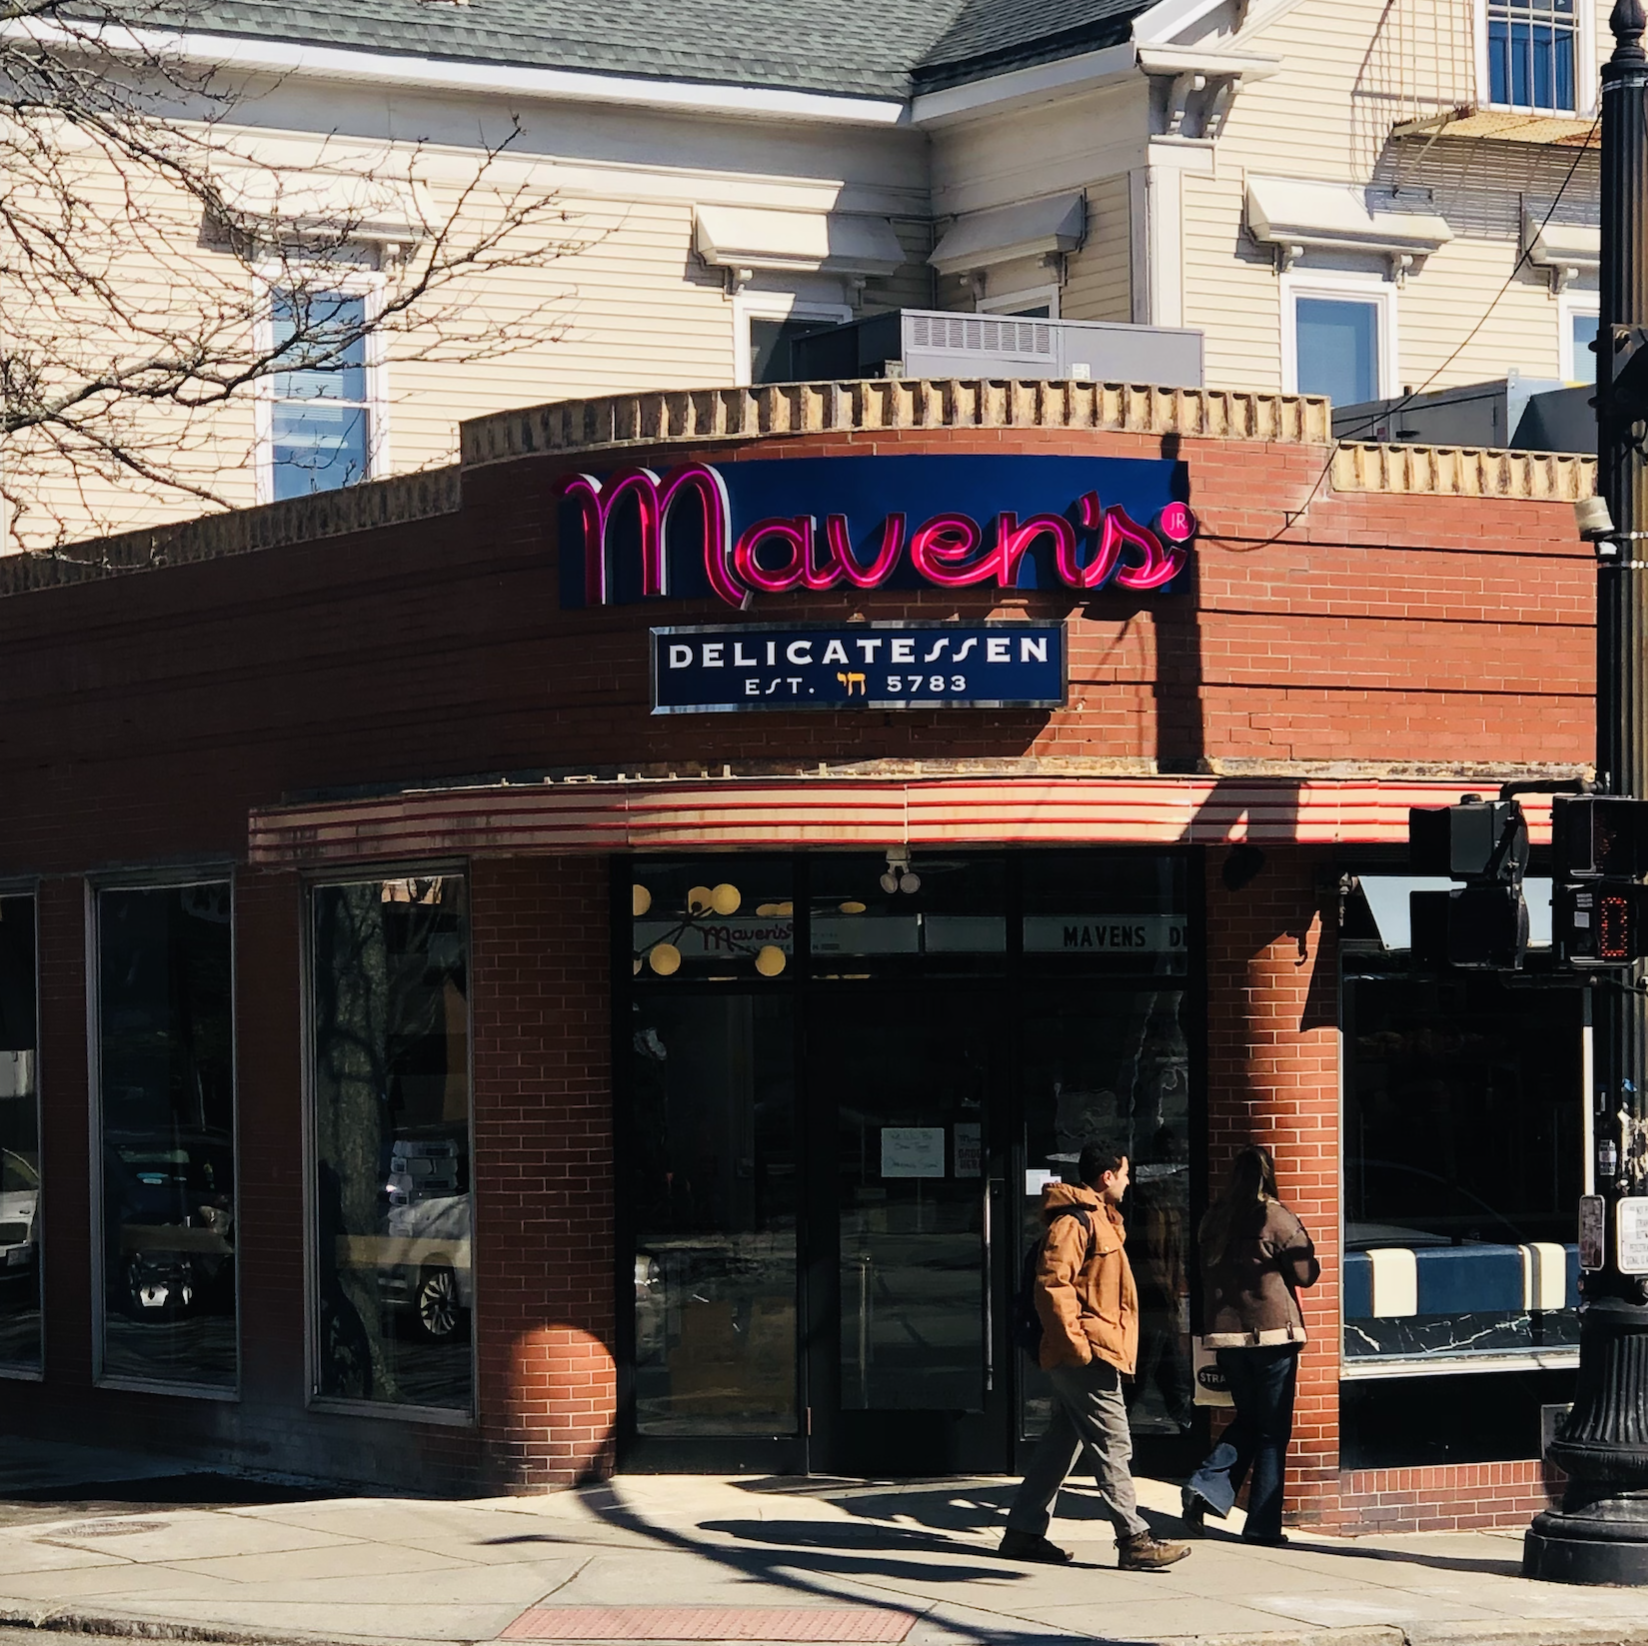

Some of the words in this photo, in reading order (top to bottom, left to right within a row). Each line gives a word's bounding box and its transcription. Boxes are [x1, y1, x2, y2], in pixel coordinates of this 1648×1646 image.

[551, 461, 1188, 611] Maven's
[668, 637, 1049, 669] DELICATESSEN
[745, 677, 816, 695] EST.
[886, 674, 968, 693] 5783
[1063, 926, 1148, 948] MAVENS
